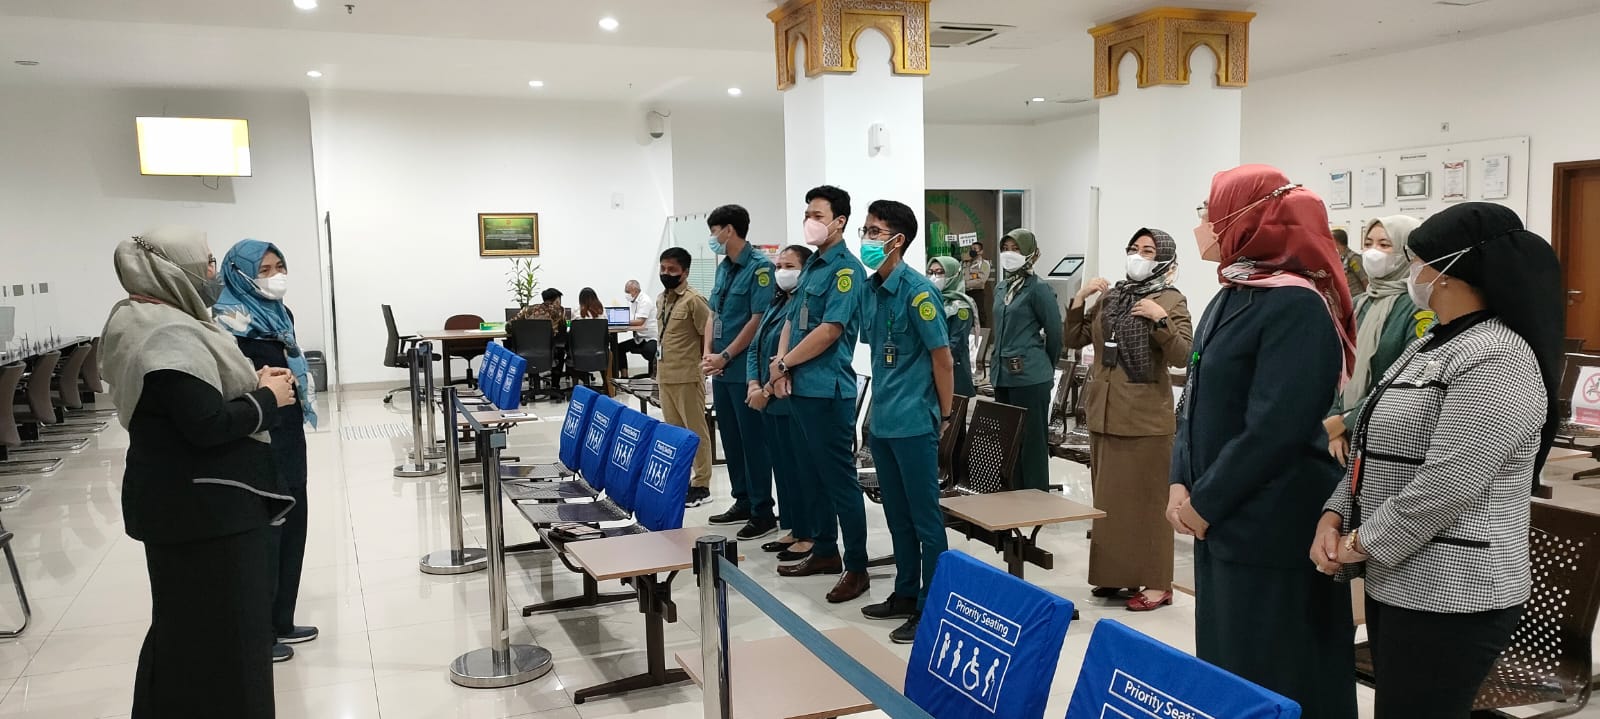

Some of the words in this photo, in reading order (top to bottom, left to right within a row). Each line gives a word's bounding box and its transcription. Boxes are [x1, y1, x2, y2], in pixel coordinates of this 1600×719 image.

[955, 600, 981, 623] Priority
[981, 613, 1009, 638] Seating
[1124, 680, 1164, 713] Priority
[1164, 702, 1196, 719] Seati
